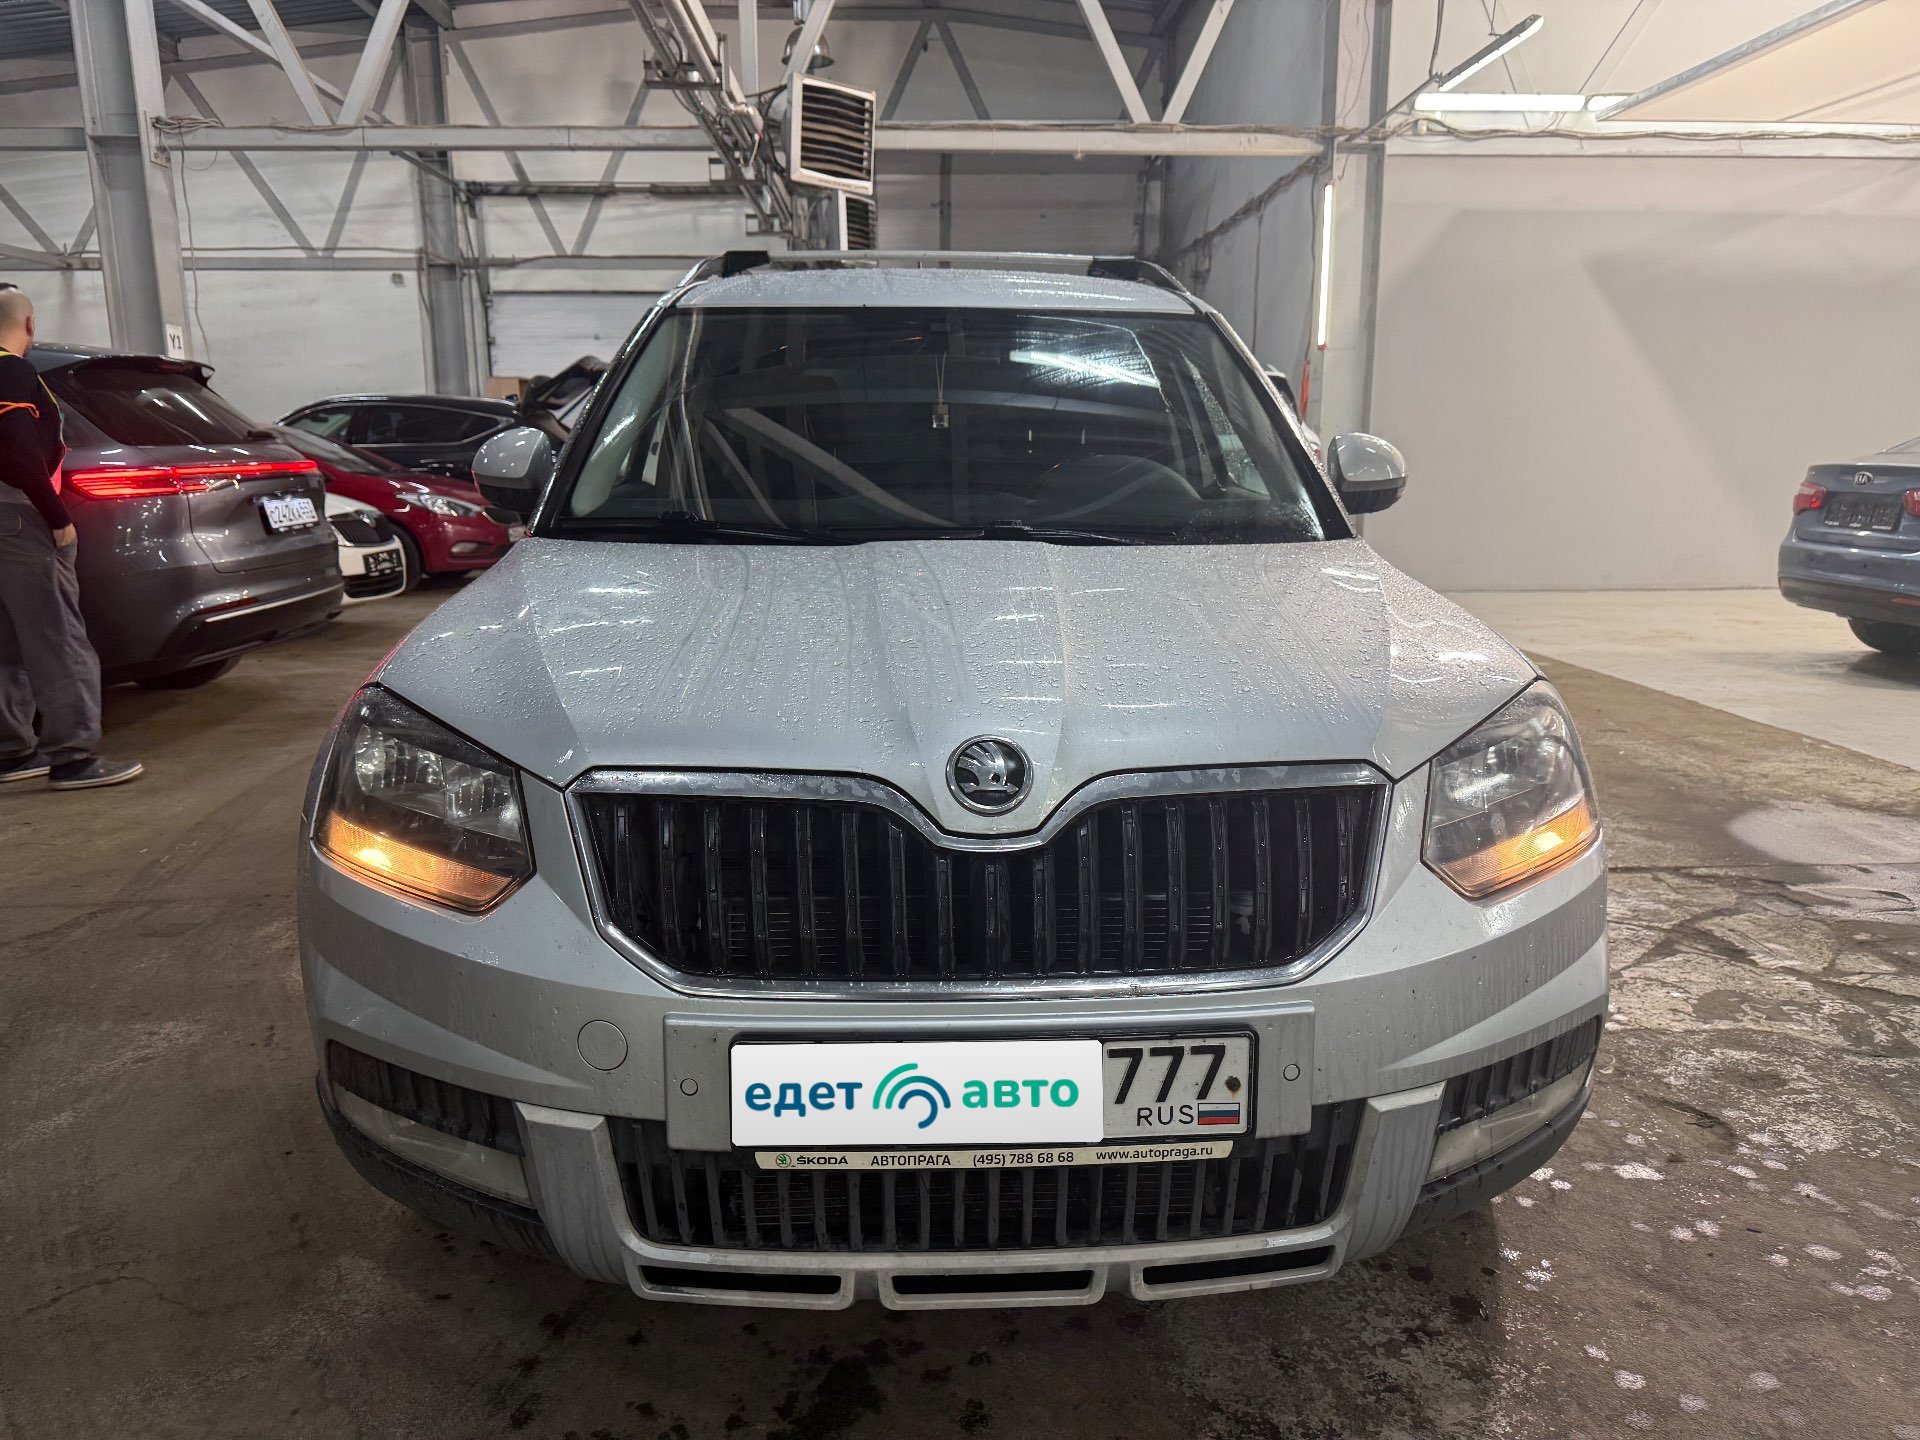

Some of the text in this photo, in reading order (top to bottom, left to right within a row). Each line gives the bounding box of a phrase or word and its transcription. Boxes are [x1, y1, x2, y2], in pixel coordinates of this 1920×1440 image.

[1854, 474, 1869, 484] KIA
[1108, 1045, 1226, 1104] 777
[1136, 1105, 1195, 1126] RUS
[870, 1154, 951, 1167] АВТОПРАГА
[972, 1153, 1007, 1168] (495)
[1009, 1153, 1034, 1165] 788
[1037, 1153, 1054, 1164] 68
[1057, 1152, 1074, 1163] 68
[1095, 1146, 1213, 1160] www.autopraga.ru
